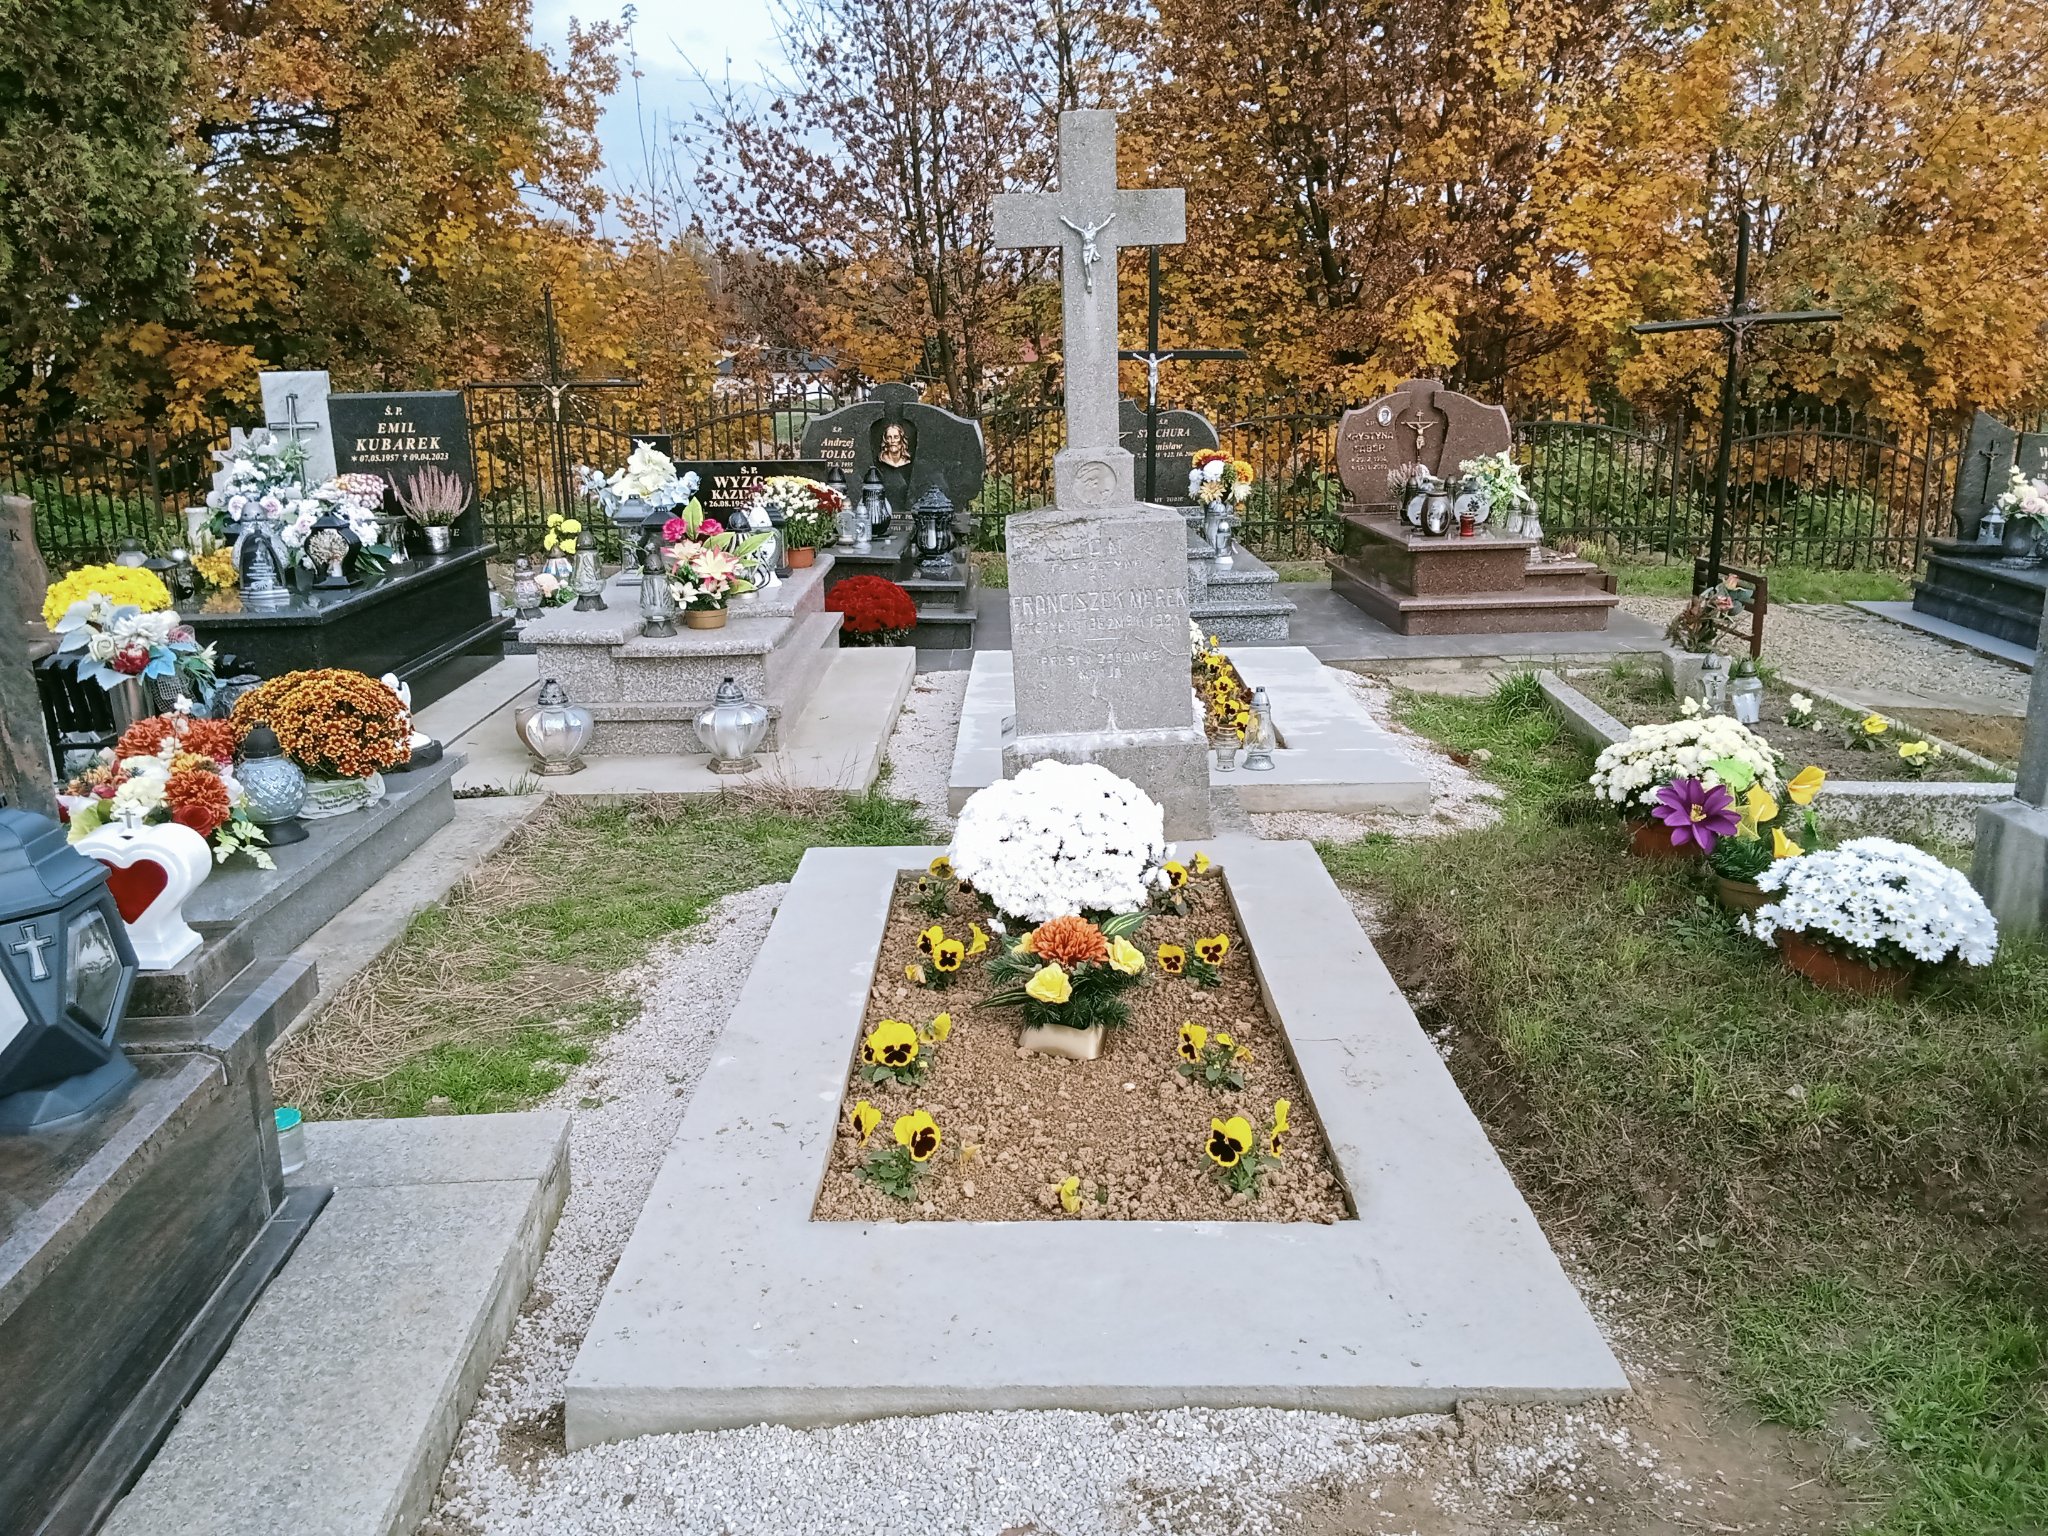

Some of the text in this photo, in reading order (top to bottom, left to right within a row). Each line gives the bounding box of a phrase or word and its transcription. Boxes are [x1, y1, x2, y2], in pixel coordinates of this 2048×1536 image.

[377, 422, 416, 434] EMIL
[1136, 428, 1191, 439] STCHURA
[355, 436, 441, 452] KUBAREK
[820, 437, 855, 449] Andrzej
[359, 452, 449, 463] 07.05.1957 09.04.2023
[820, 449, 856, 459] TOLKO
[713, 475, 764, 489] WYZG
[709, 500, 744, 508] 26.08.195
[1010, 588, 1125, 615] FRANCISZEK
